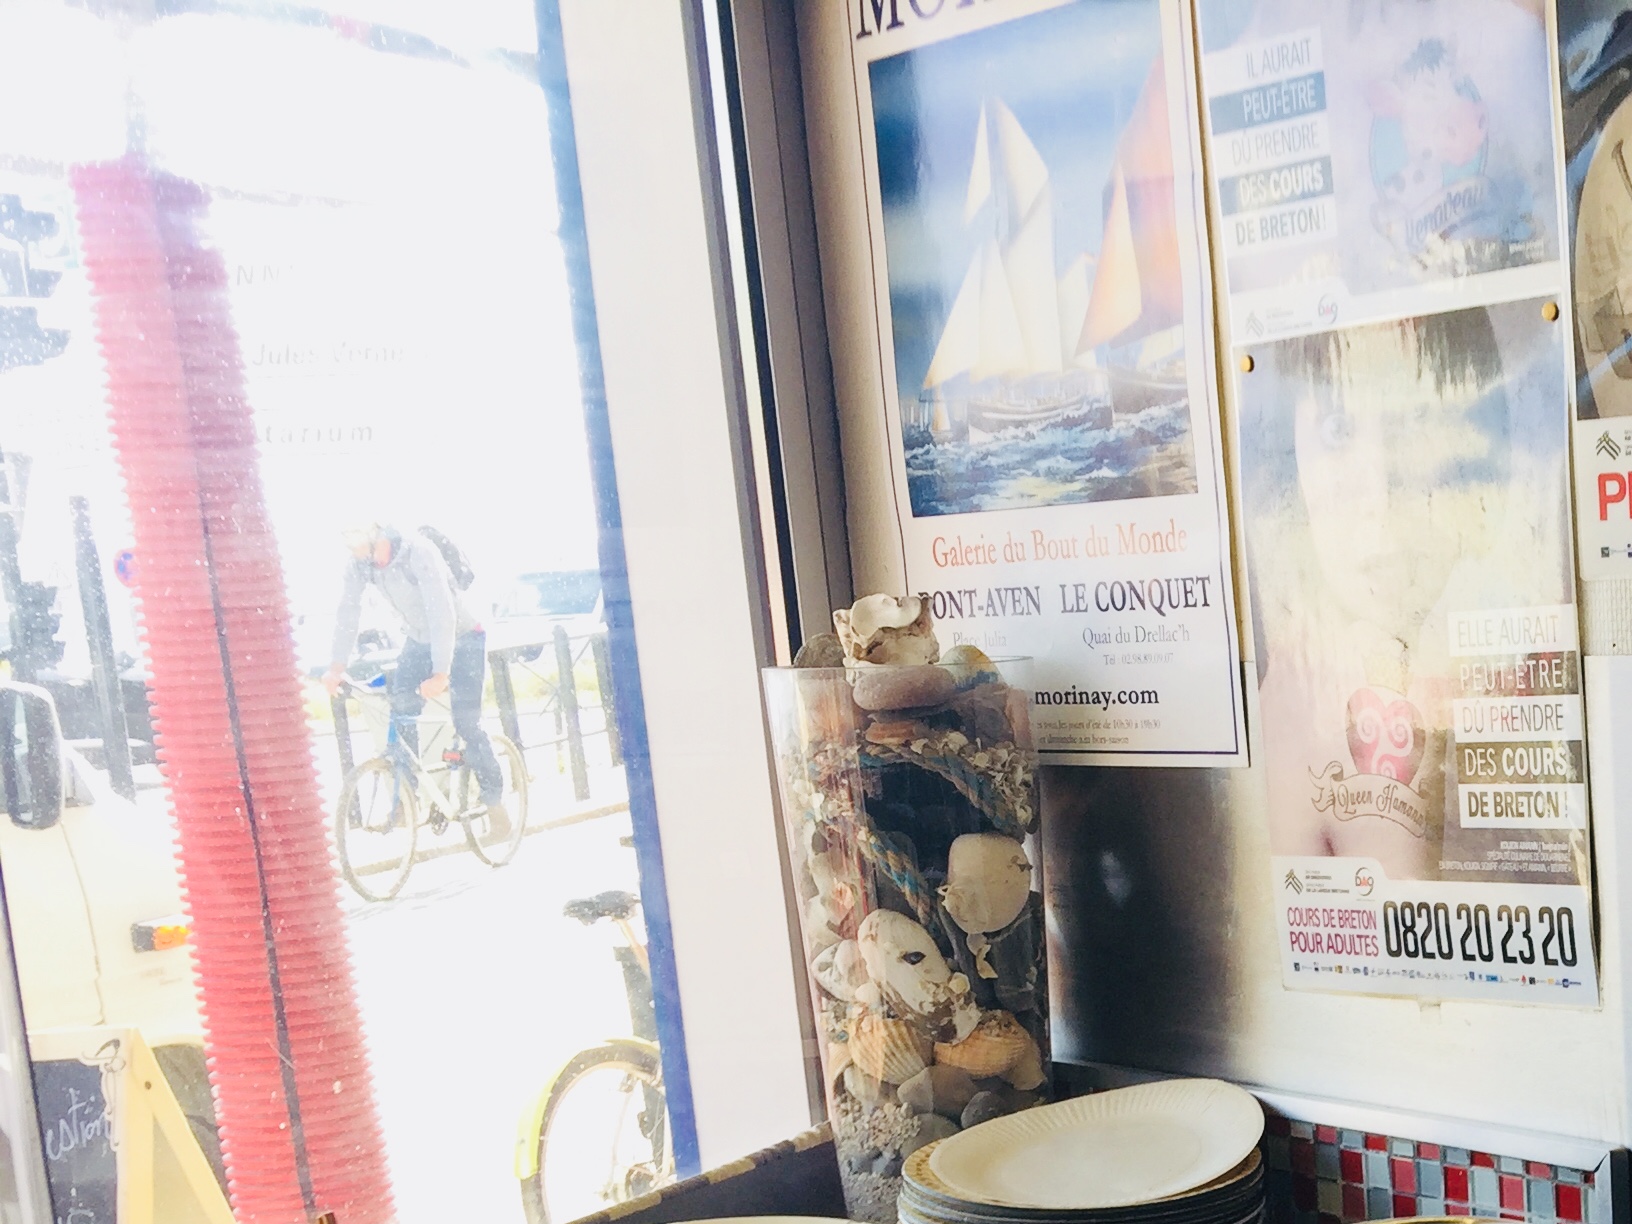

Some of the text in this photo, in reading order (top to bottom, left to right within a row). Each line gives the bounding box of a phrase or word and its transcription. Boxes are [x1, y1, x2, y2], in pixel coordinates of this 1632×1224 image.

[1246, 37, 1312, 78] IL AURAIT
[1243, 77, 1317, 123] PEUT-ÊTRE
[1231, 121, 1320, 167] DÛ PRENDRE
[1239, 160, 1324, 210] DES COURS
[1235, 220, 1255, 247] DE
[265, 424, 375, 445] tarium
[931, 518, 1188, 568] Galerie du Bout du Monde
[1058, 583, 1089, 614] LE
[1094, 574, 1212, 617] CONQUET
[1082, 627, 1112, 650] Quai
[1115, 625, 1132, 645] du
[1458, 614, 1559, 648] ELLE AURAIT
[1460, 654, 1563, 691] PEUT-ÊTRE
[1463, 699, 1565, 734] DÛ PRENDRE
[1465, 747, 1568, 778] DES COURS
[1337, 783, 1373, 815] Queen
[1468, 791, 1489, 818] DE
[1494, 790, 1560, 819] BRETON
[1287, 900, 1579, 967] COURS DE BRETON 0820 20 23 20
[1289, 931, 1379, 958] POUR ADULTES
